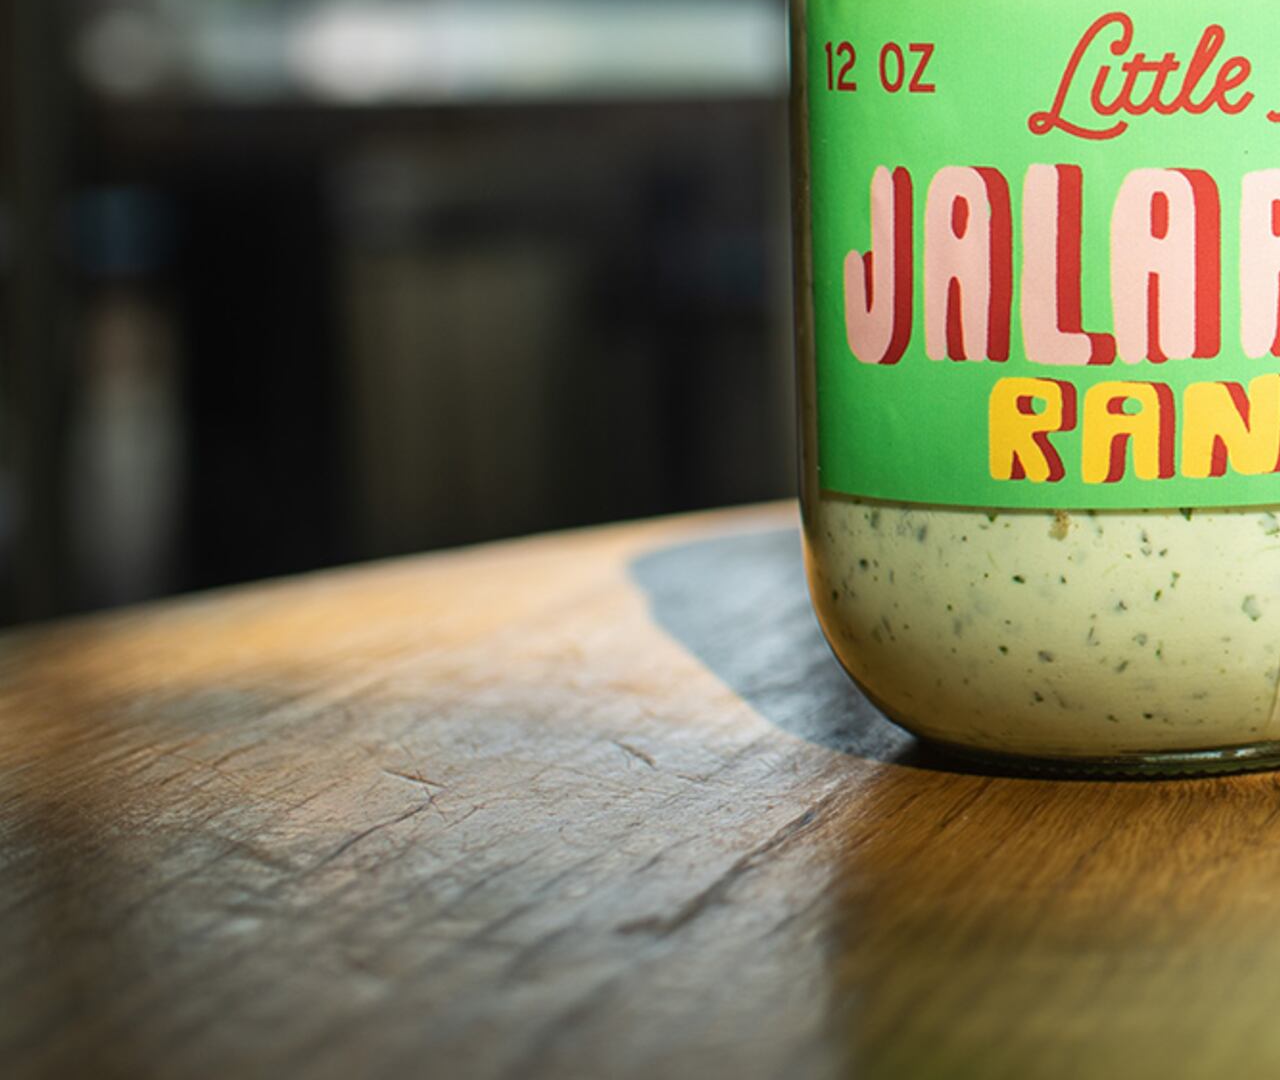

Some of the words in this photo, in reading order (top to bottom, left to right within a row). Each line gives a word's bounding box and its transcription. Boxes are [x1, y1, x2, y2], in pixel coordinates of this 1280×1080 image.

[825, 41, 857, 93] 12
[878, 43, 936, 94] OZ
[1028, 11, 1255, 141] Little
